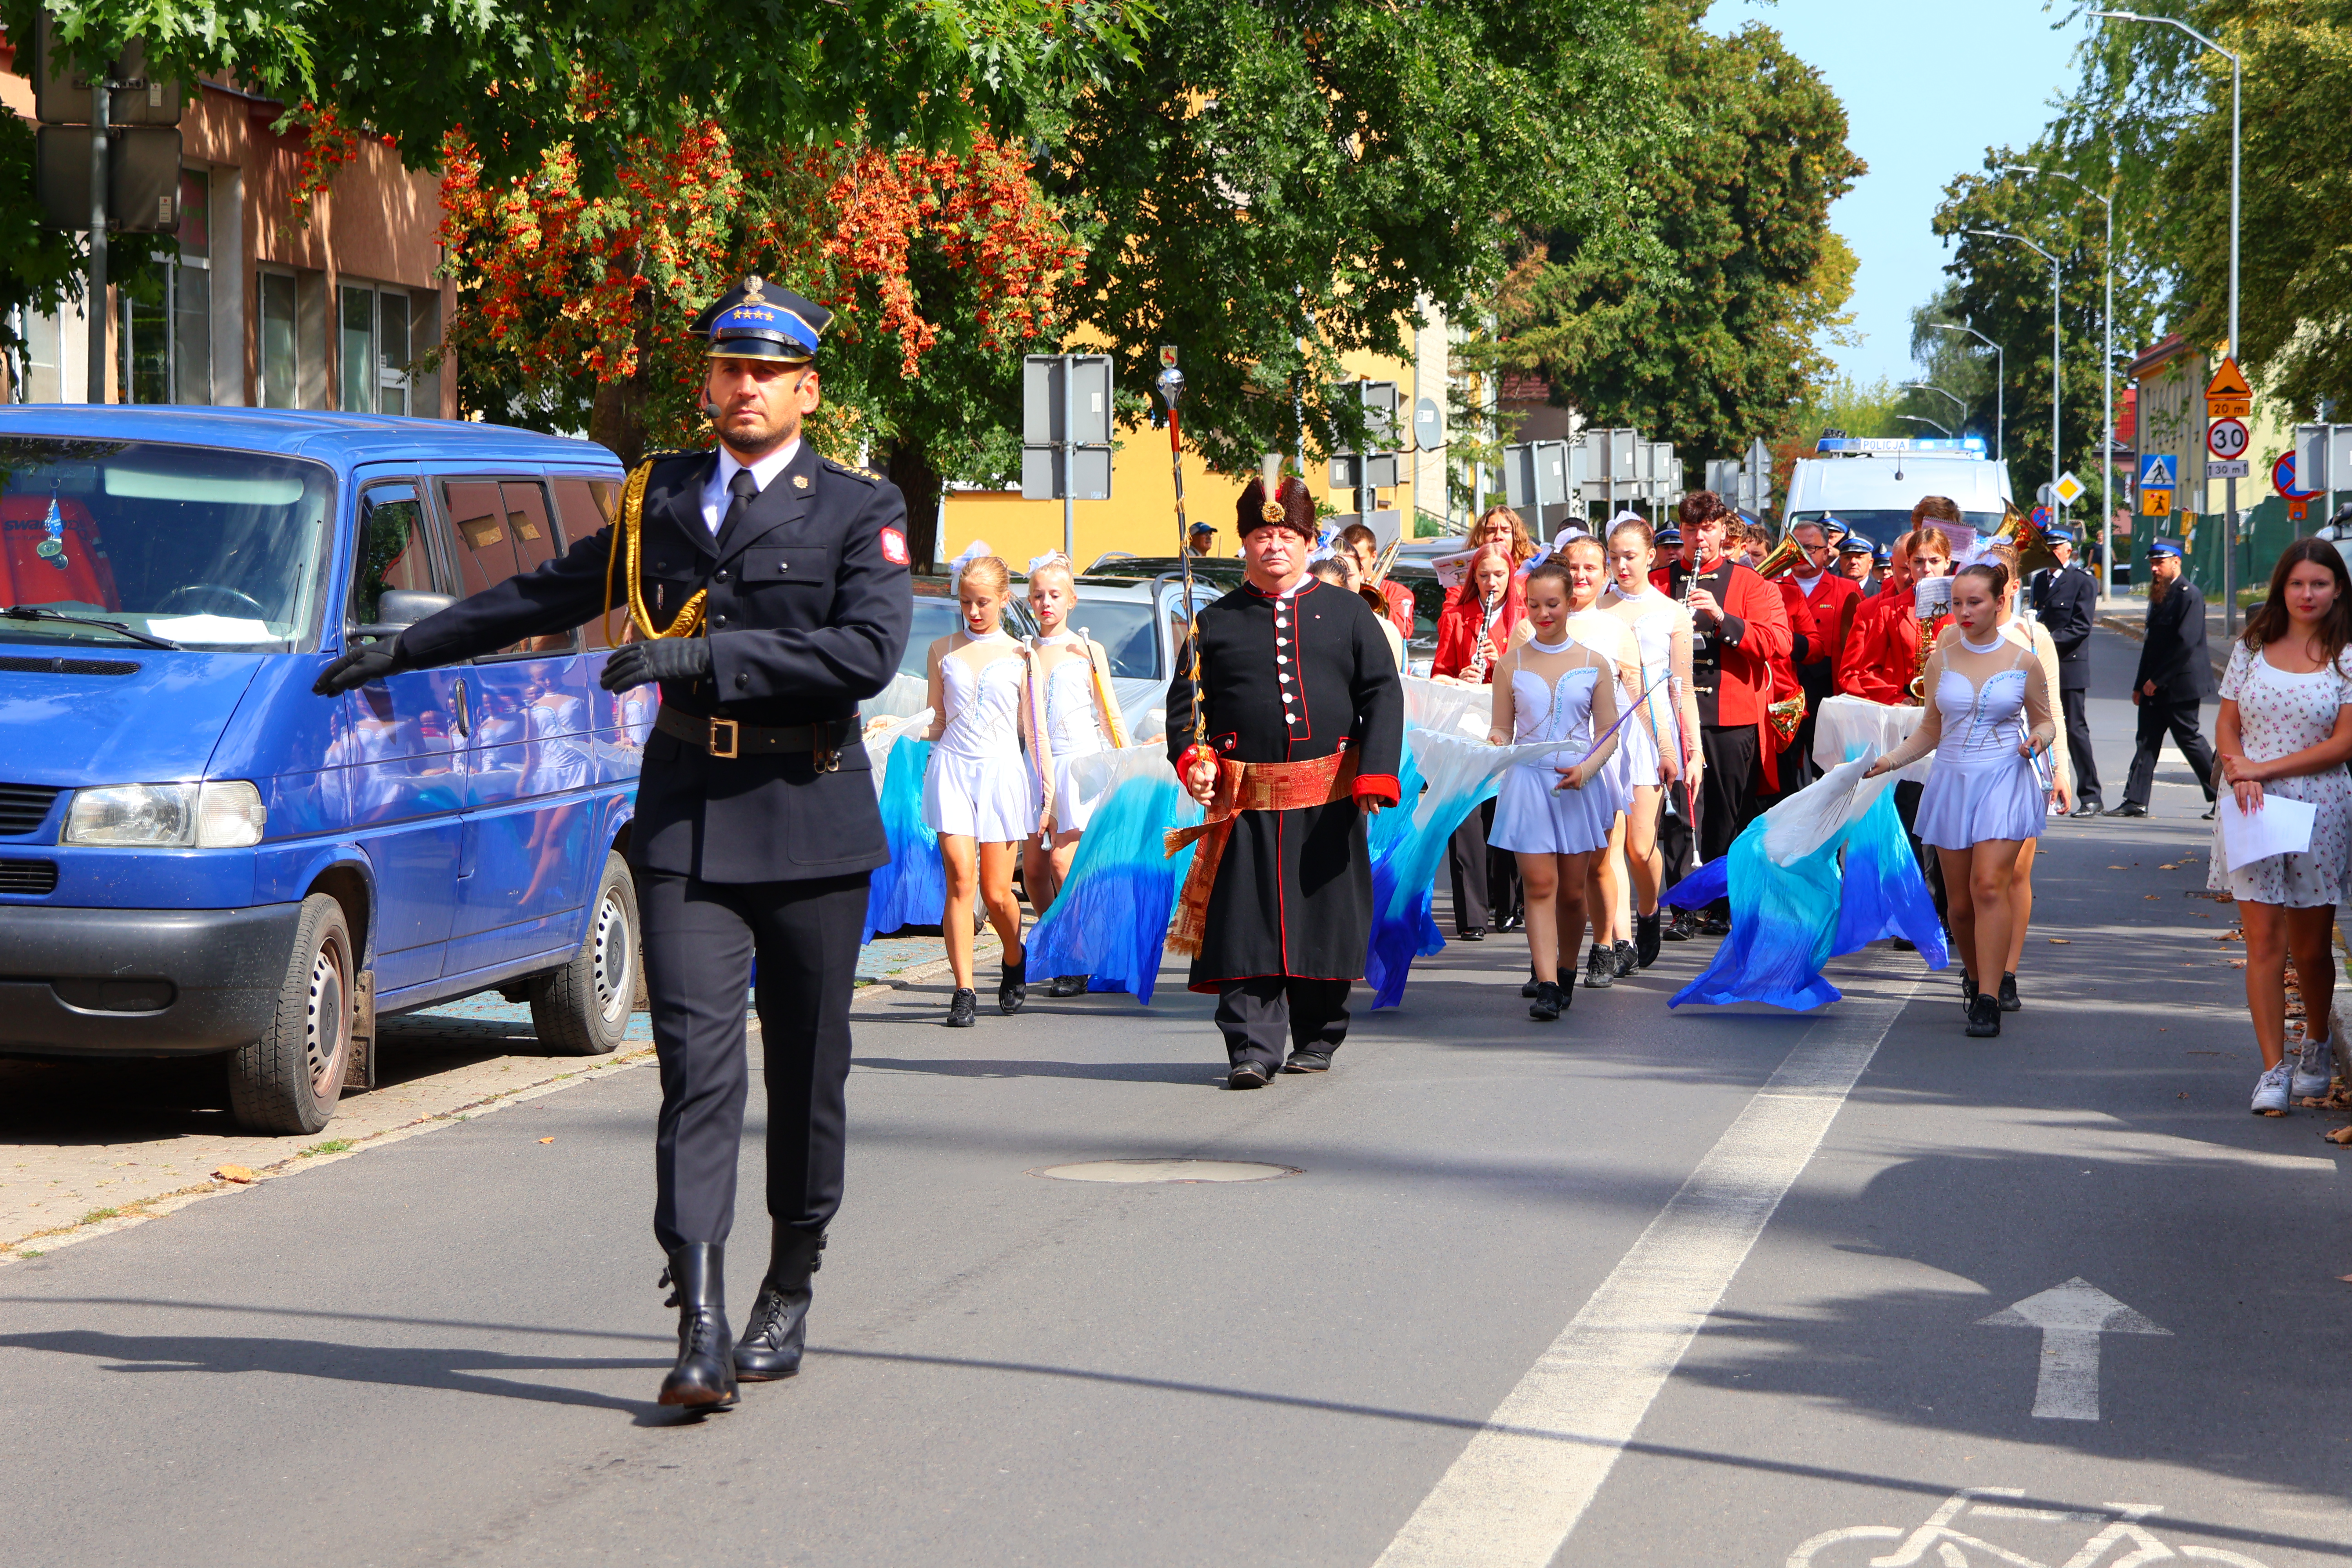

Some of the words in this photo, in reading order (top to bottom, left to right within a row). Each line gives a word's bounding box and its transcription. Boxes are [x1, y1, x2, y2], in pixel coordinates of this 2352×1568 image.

[2214, 404, 2229, 414] 20
[2214, 429, 2243, 449] 30
[1864, 441, 1906, 450] POLICJA
[2215, 466, 2227, 474] 30
